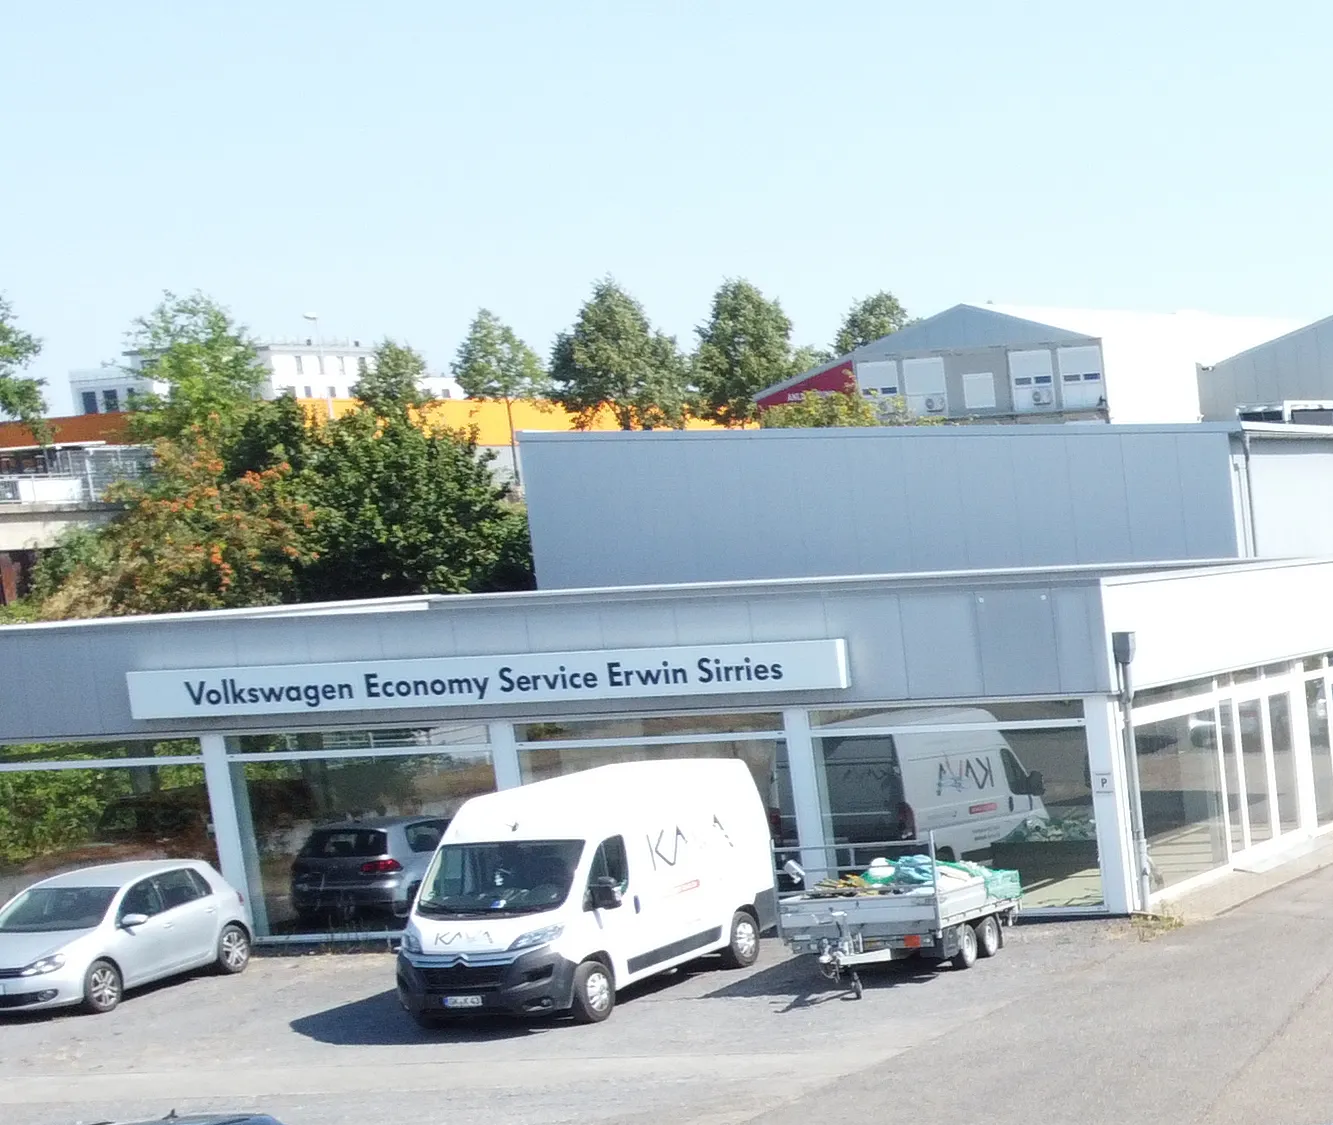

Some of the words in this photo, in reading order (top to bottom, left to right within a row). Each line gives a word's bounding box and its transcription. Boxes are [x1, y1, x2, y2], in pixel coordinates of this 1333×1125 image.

[184, 678, 355, 708] Volkswagen
[363, 672, 490, 700] Economy
[499, 665, 599, 693] Service
[607, 660, 689, 688] Erwin
[697, 656, 784, 684] Sirries
[646, 813, 734, 871] KAA
